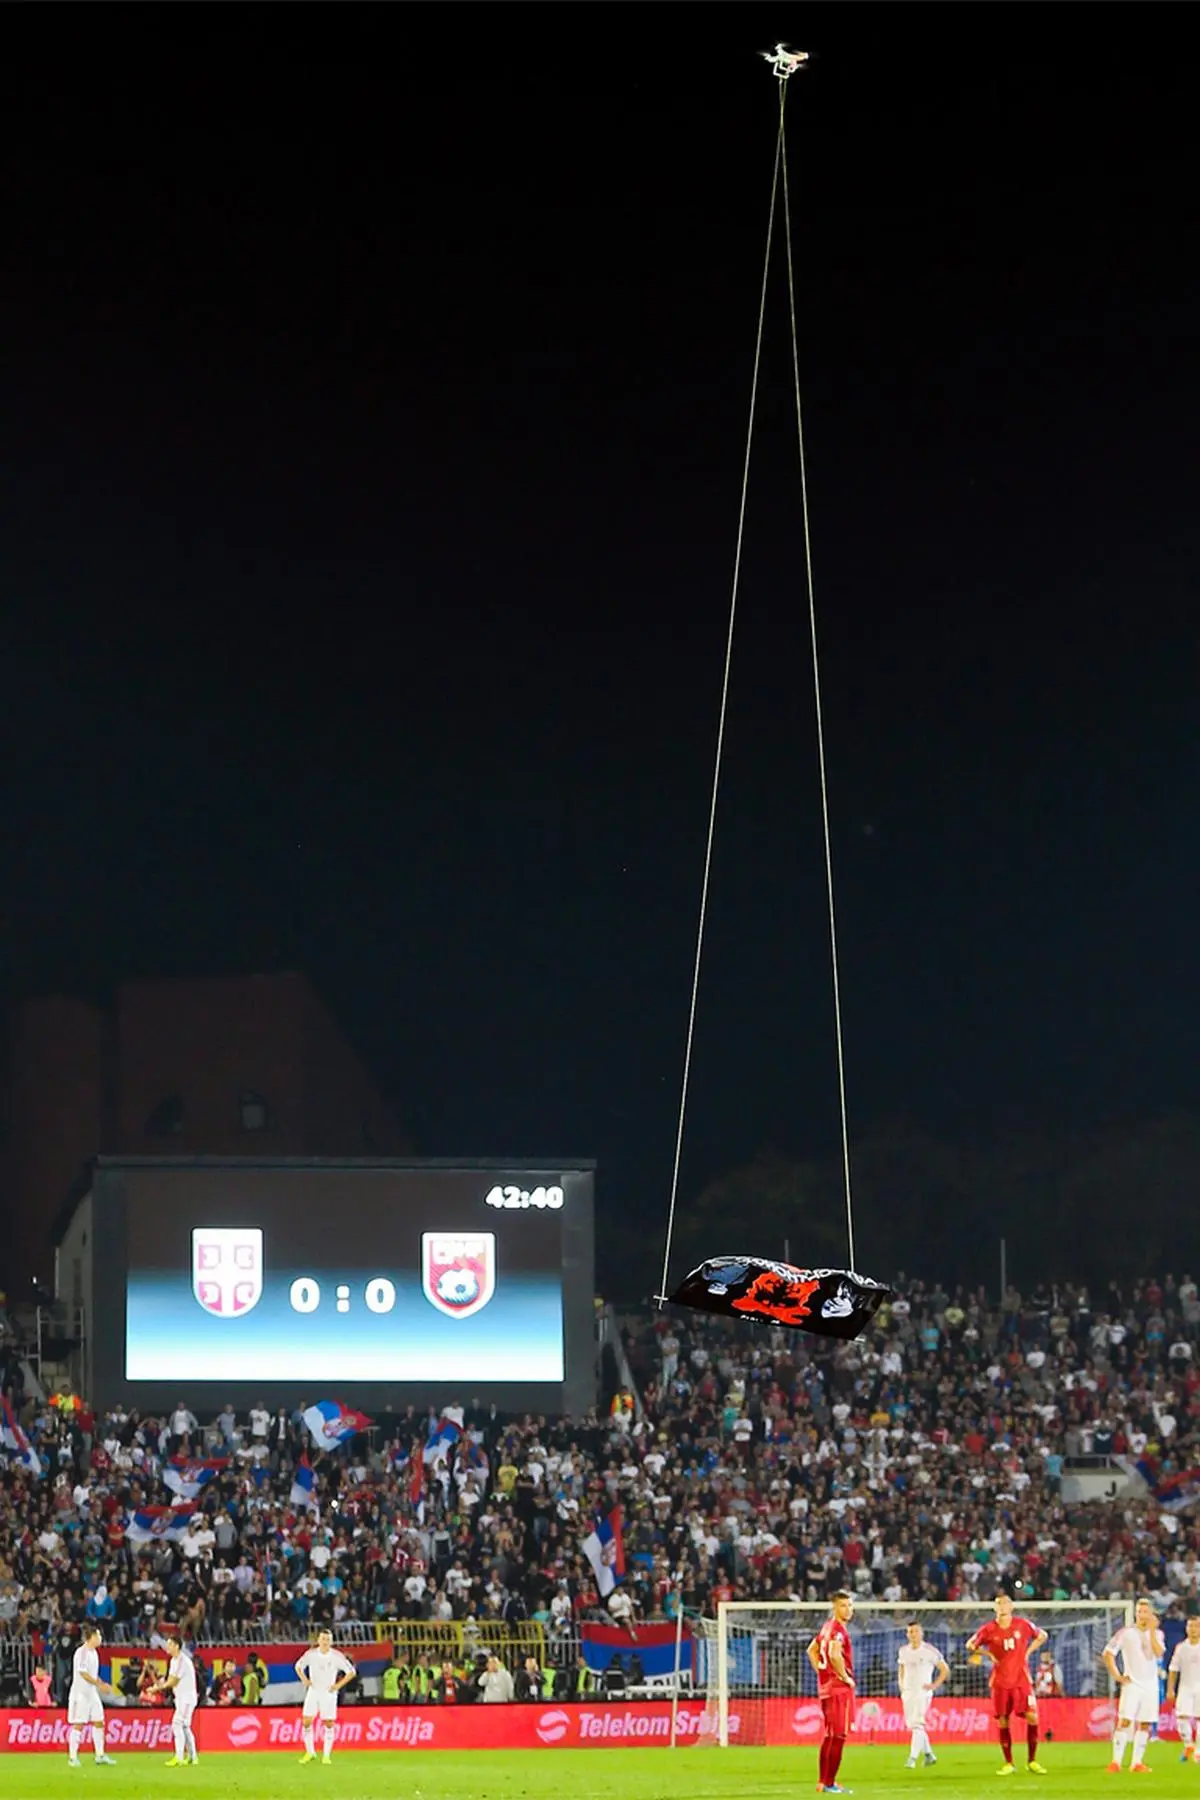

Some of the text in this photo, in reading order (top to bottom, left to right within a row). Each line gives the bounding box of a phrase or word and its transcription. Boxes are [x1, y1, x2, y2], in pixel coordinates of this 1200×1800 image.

[485, 1185, 564, 1209] 42:40
[1104, 1480, 1117, 1497] J
[1003, 1637, 1015, 1651] 14
[107, 1718, 174, 1748] Srbija
[366, 1715, 434, 1745] Srbija
[579, 1712, 669, 1738] Telekom
[926, 1707, 989, 1736] Srbija
